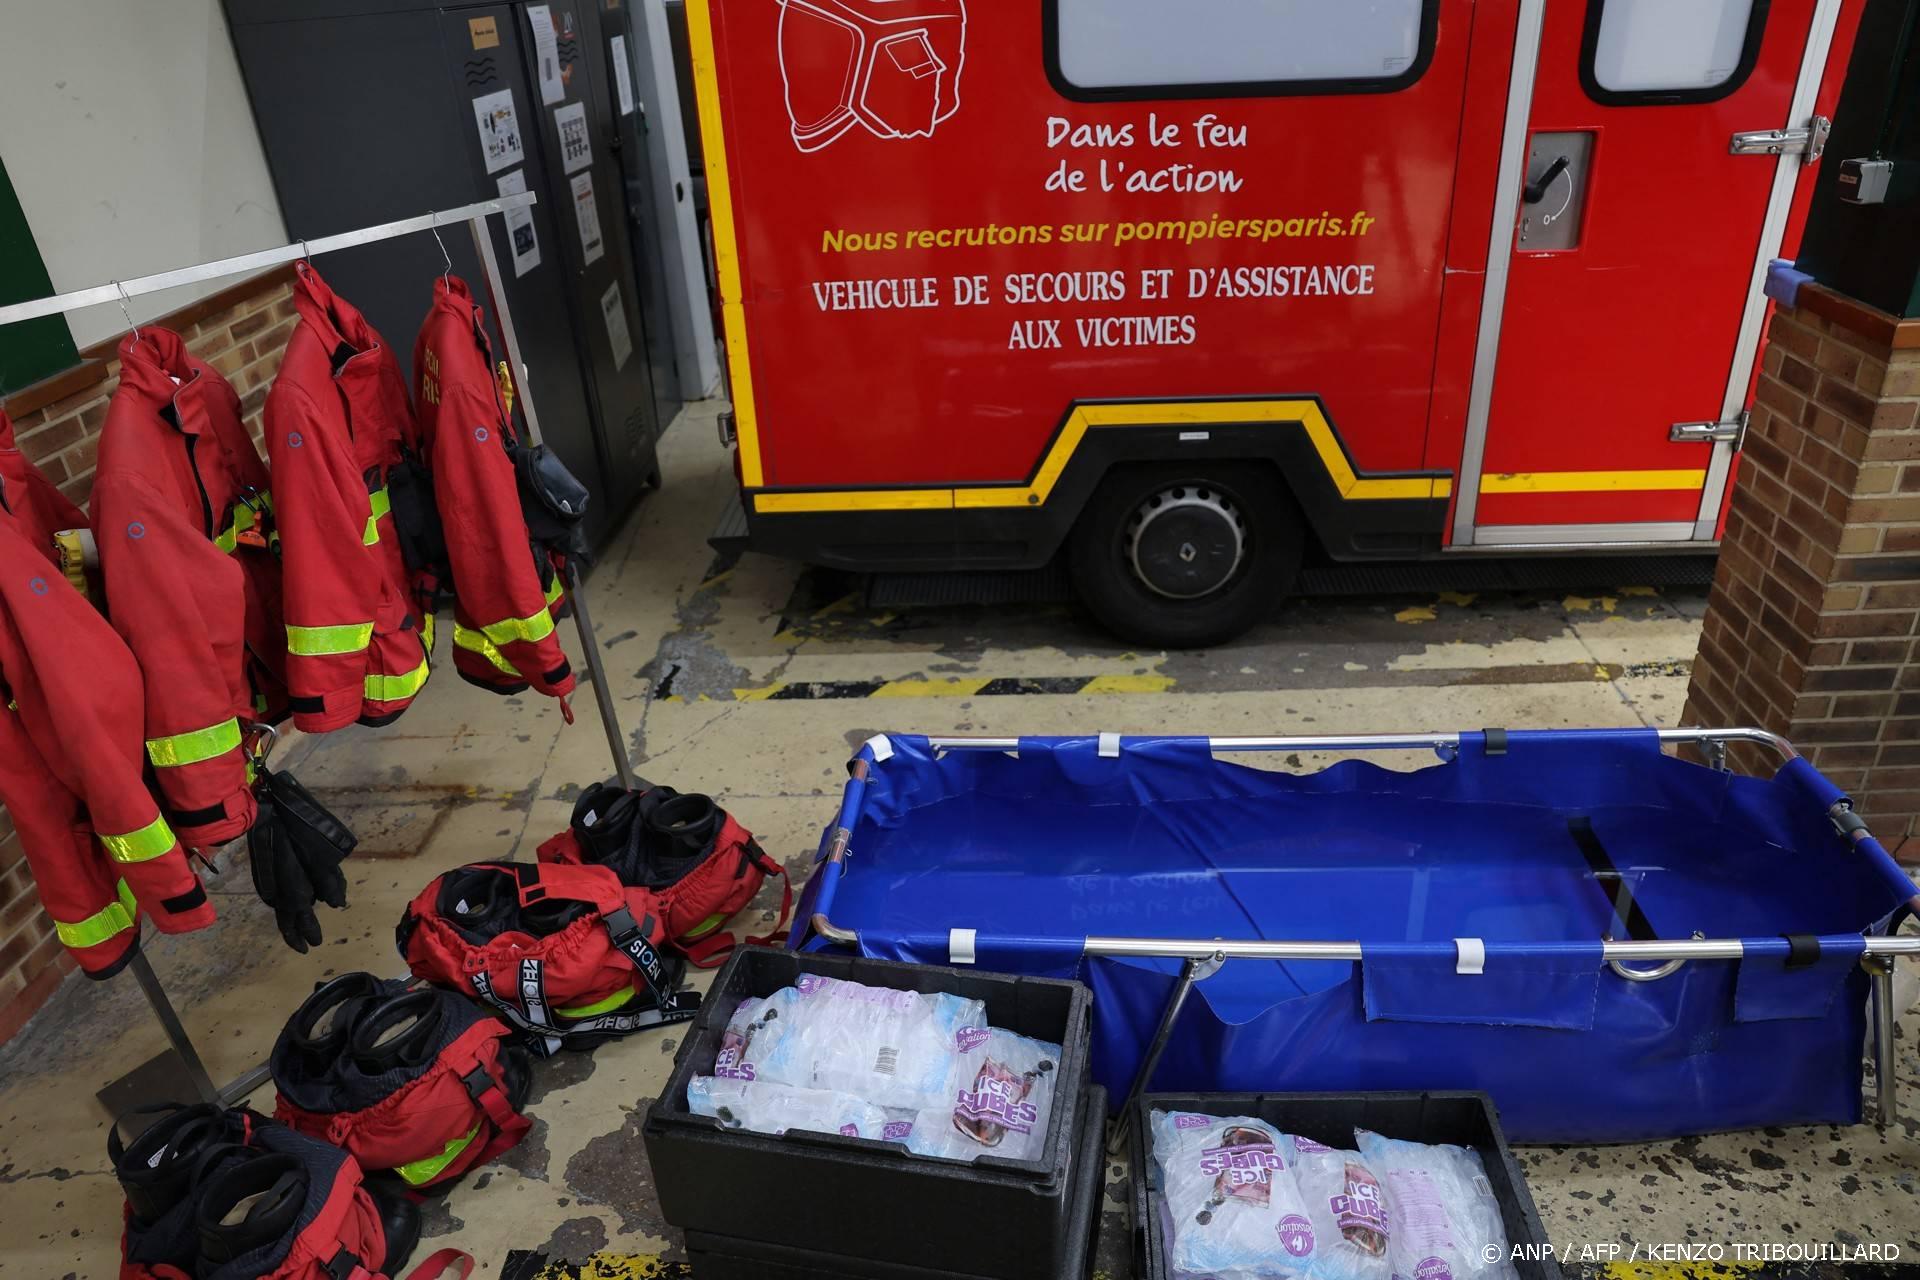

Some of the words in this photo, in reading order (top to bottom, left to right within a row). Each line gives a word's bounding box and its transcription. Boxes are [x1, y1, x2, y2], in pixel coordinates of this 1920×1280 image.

[1047, 116, 1134, 148] Dans
[1149, 112, 1181, 147] le
[1193, 113, 1247, 148] feu
[1044, 159, 1087, 192] de
[1100, 159, 1243, 193] l'action
[822, 229, 898, 253] Nous
[906, 223, 1052, 249] recrutons
[1059, 223, 1109, 242] sur
[1115, 211, 1375, 247] pompiersparis.fr
[812, 277, 939, 312] VEHICULE
[953, 275, 990, 306] DE
[1004, 270, 1126, 304] SECOURS
[1140, 269, 1174, 300] ET
[1188, 264, 1375, 298] D'ASSISTANCE
[1007, 319, 1062, 350] AUX
[1075, 314, 1196, 348] VICTIMES
[979, 1075, 1012, 1099] ICE
[957, 1089, 1037, 1124] CUBES
[1200, 1150, 1286, 1177] CUBES
[1231, 1168, 1267, 1185] ICE
